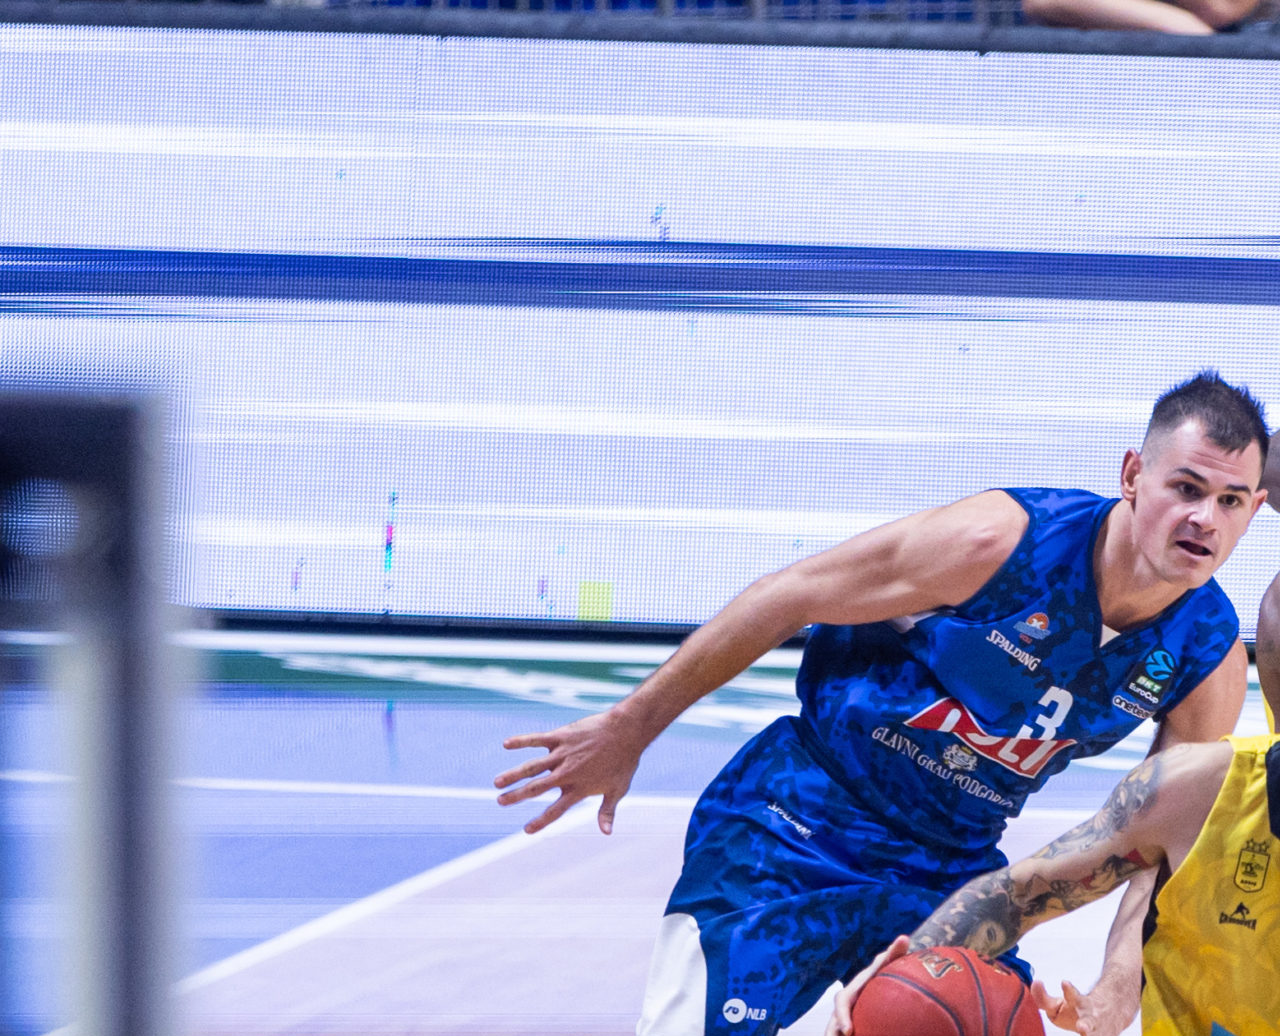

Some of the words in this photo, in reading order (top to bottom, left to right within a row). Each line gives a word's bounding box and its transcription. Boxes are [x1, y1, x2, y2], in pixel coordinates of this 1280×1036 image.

[986, 629, 1042, 672] SPALDING
[1128, 682, 1160, 704] EuroCup
[1019, 685, 1074, 740] 3
[871, 726, 921, 761] GLAVNI
[746, 1007, 768, 1021] NLB
